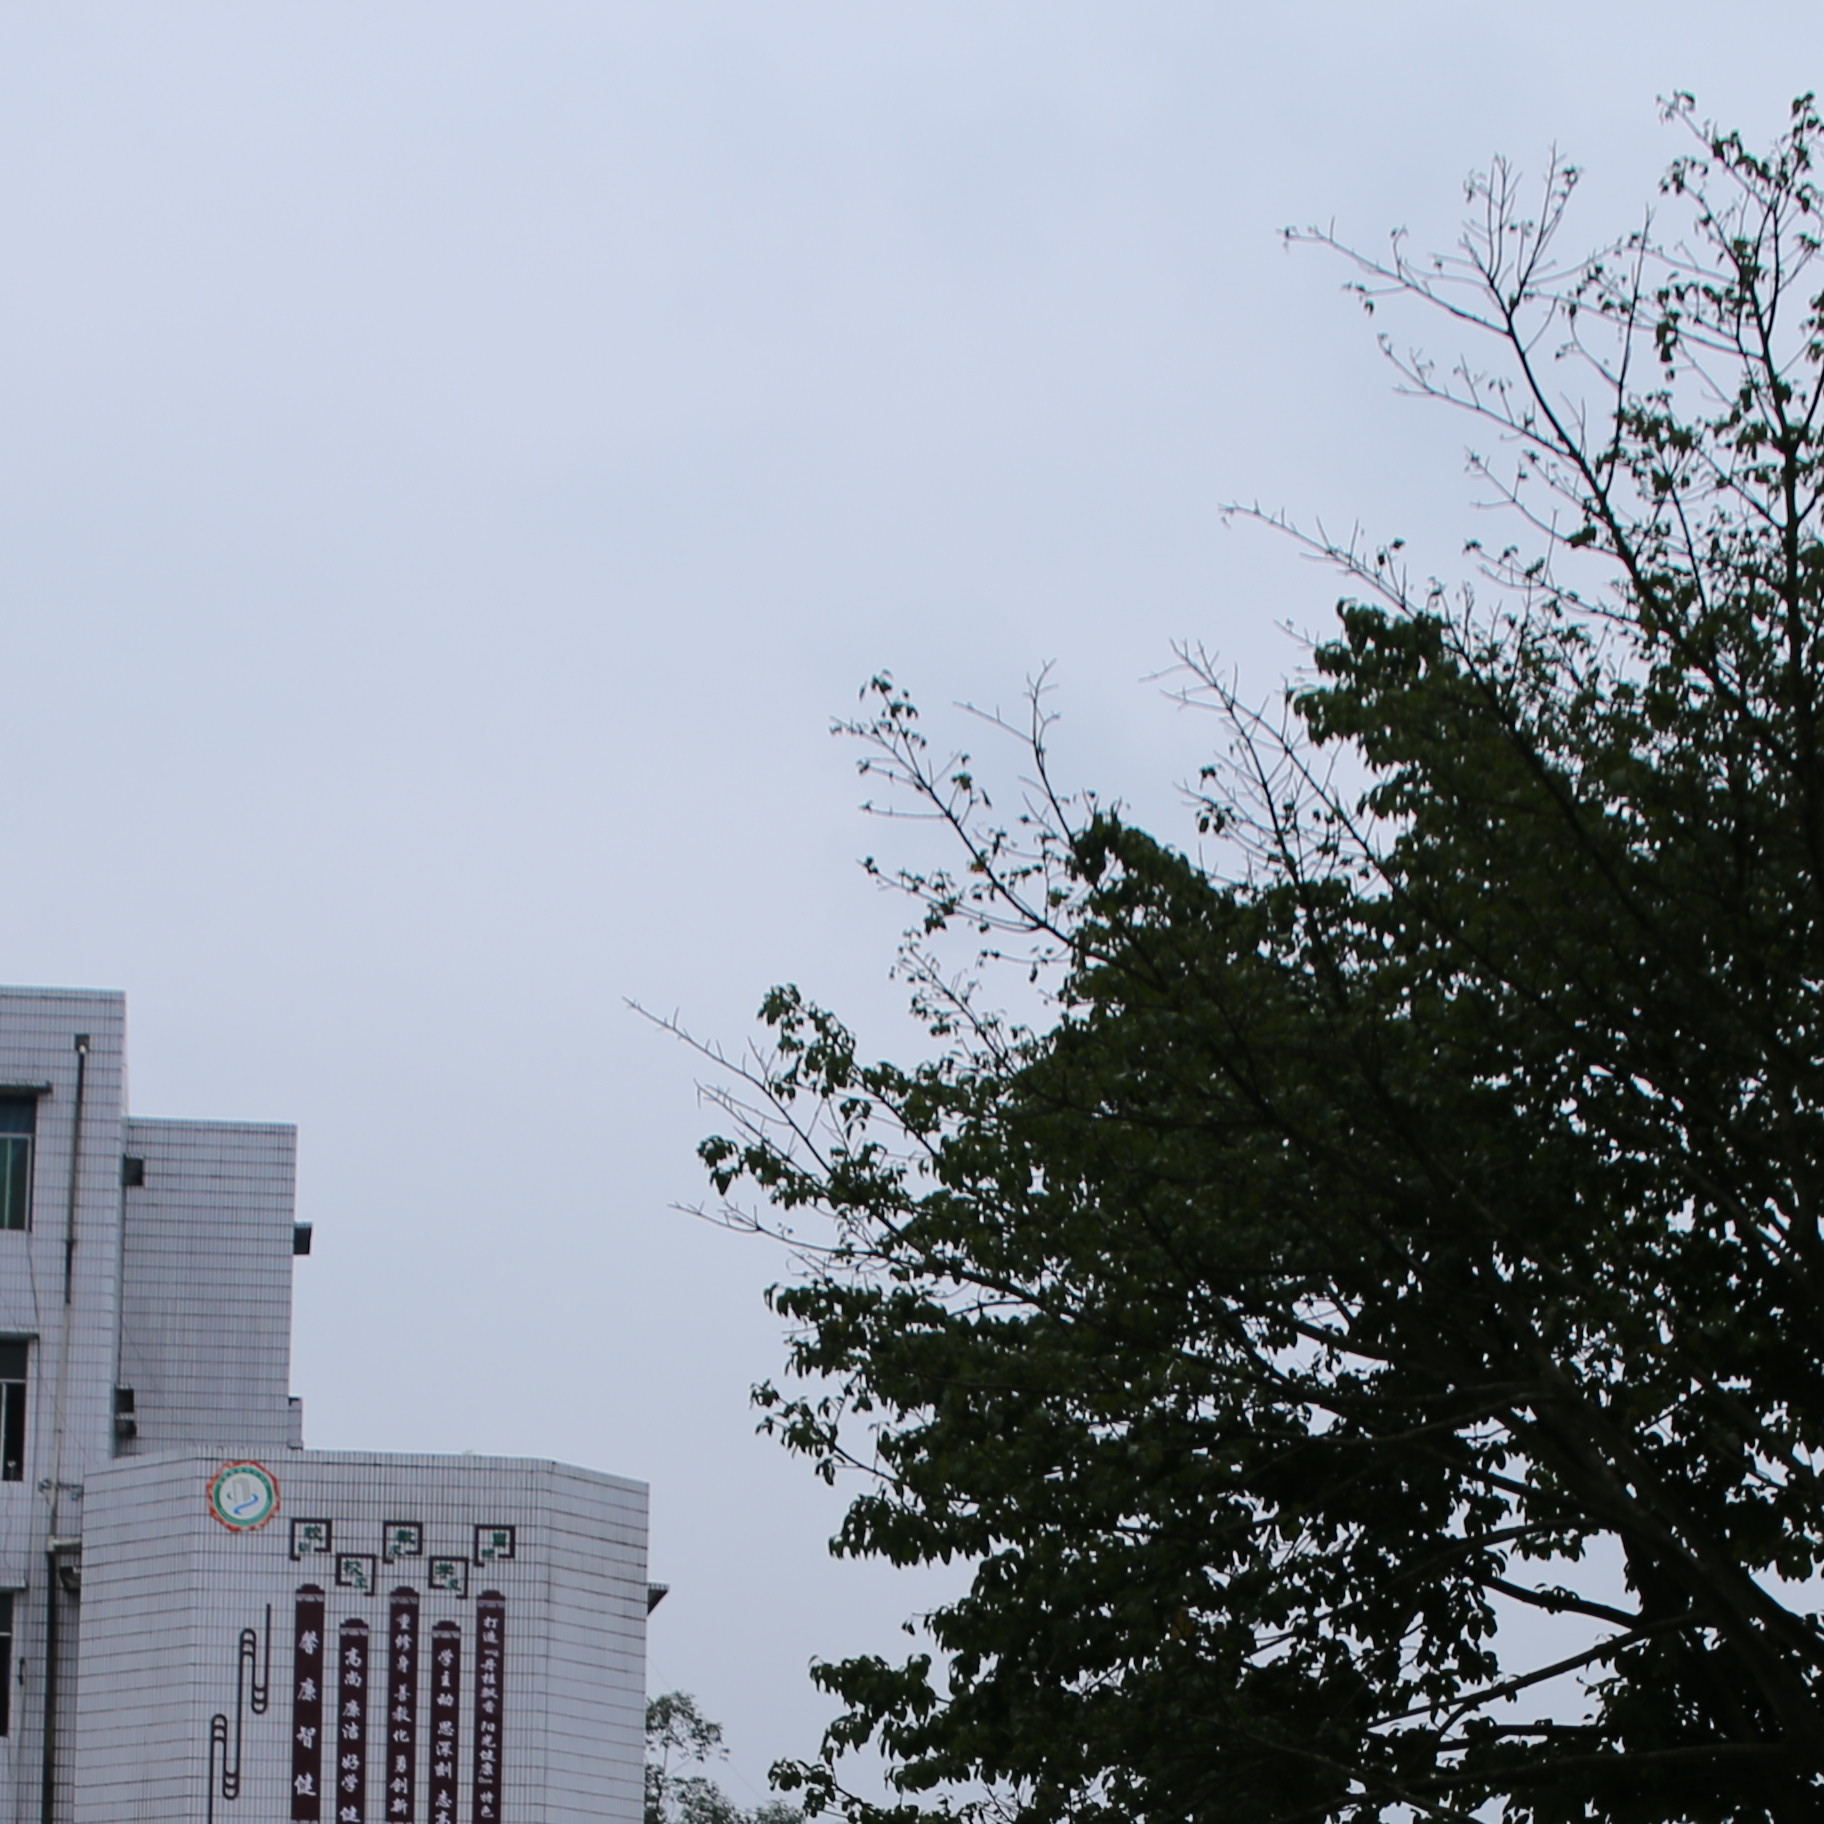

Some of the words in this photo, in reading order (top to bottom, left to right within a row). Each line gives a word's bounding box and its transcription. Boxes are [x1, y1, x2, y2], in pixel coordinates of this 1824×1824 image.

[344, 1646, 363, 1688] 高尚
[436, 1647, 455, 1707] 学主动
[342, 1698, 361, 1741] 廉洁
[341, 1752, 360, 1793] 好学
